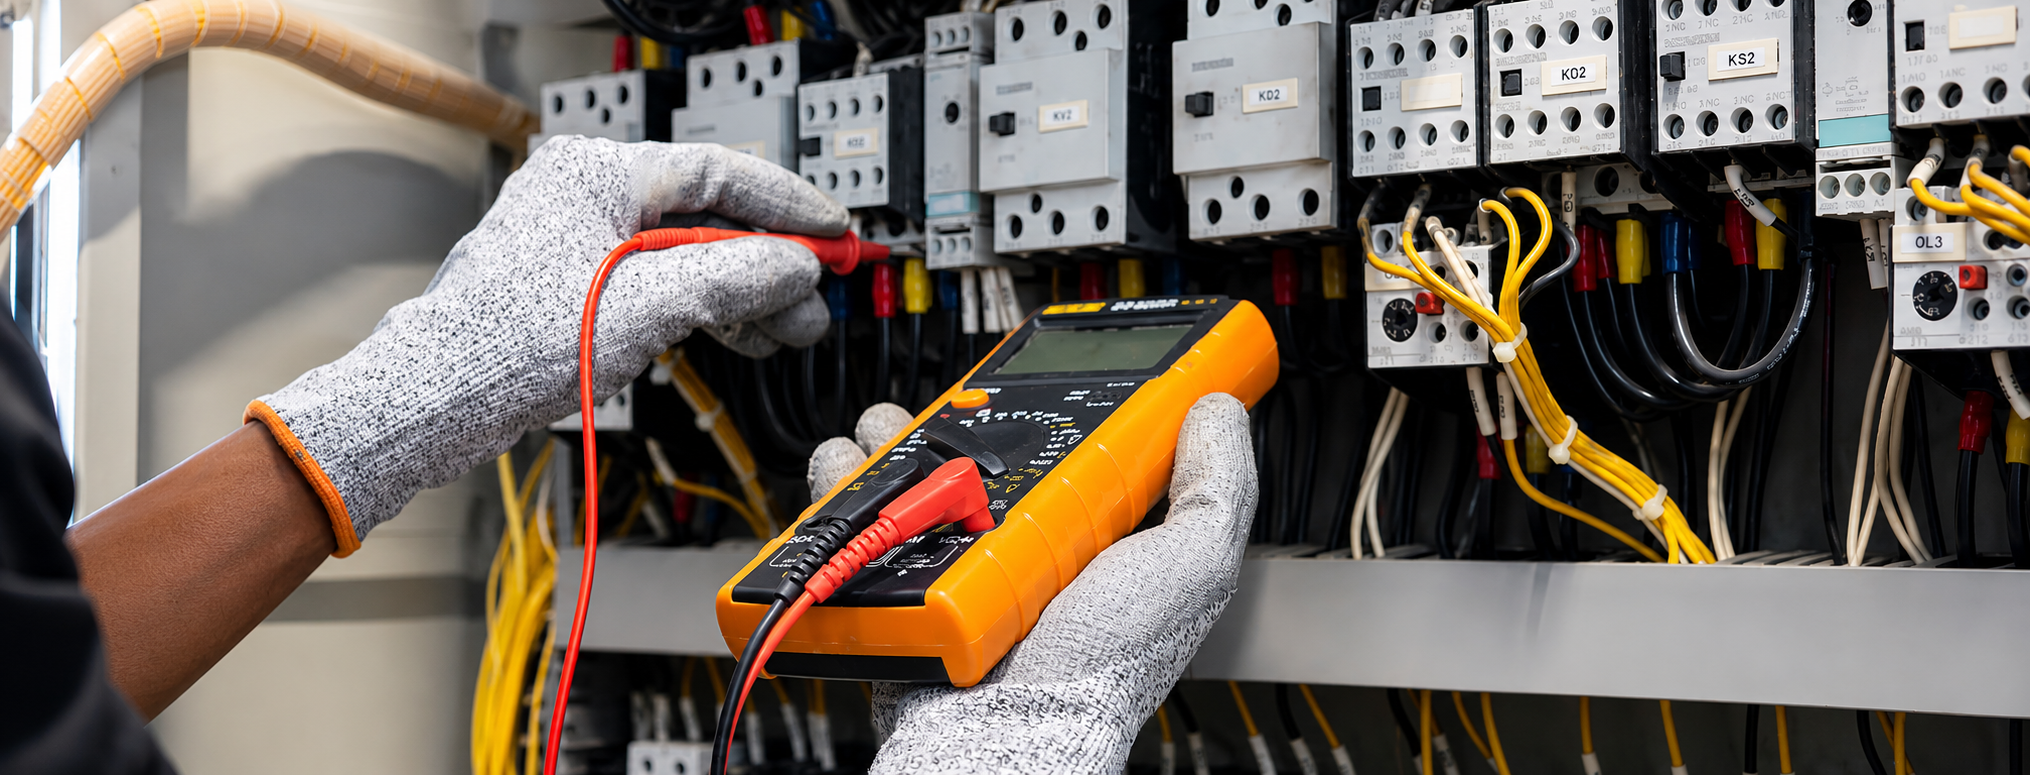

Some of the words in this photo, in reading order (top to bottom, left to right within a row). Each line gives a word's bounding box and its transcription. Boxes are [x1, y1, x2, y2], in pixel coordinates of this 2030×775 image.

[1728, 51, 1755, 67] KS2
[1258, 88, 1280, 102] KD2
[1053, 109, 1072, 122] KV2
[1915, 235, 1943, 249] OL3
